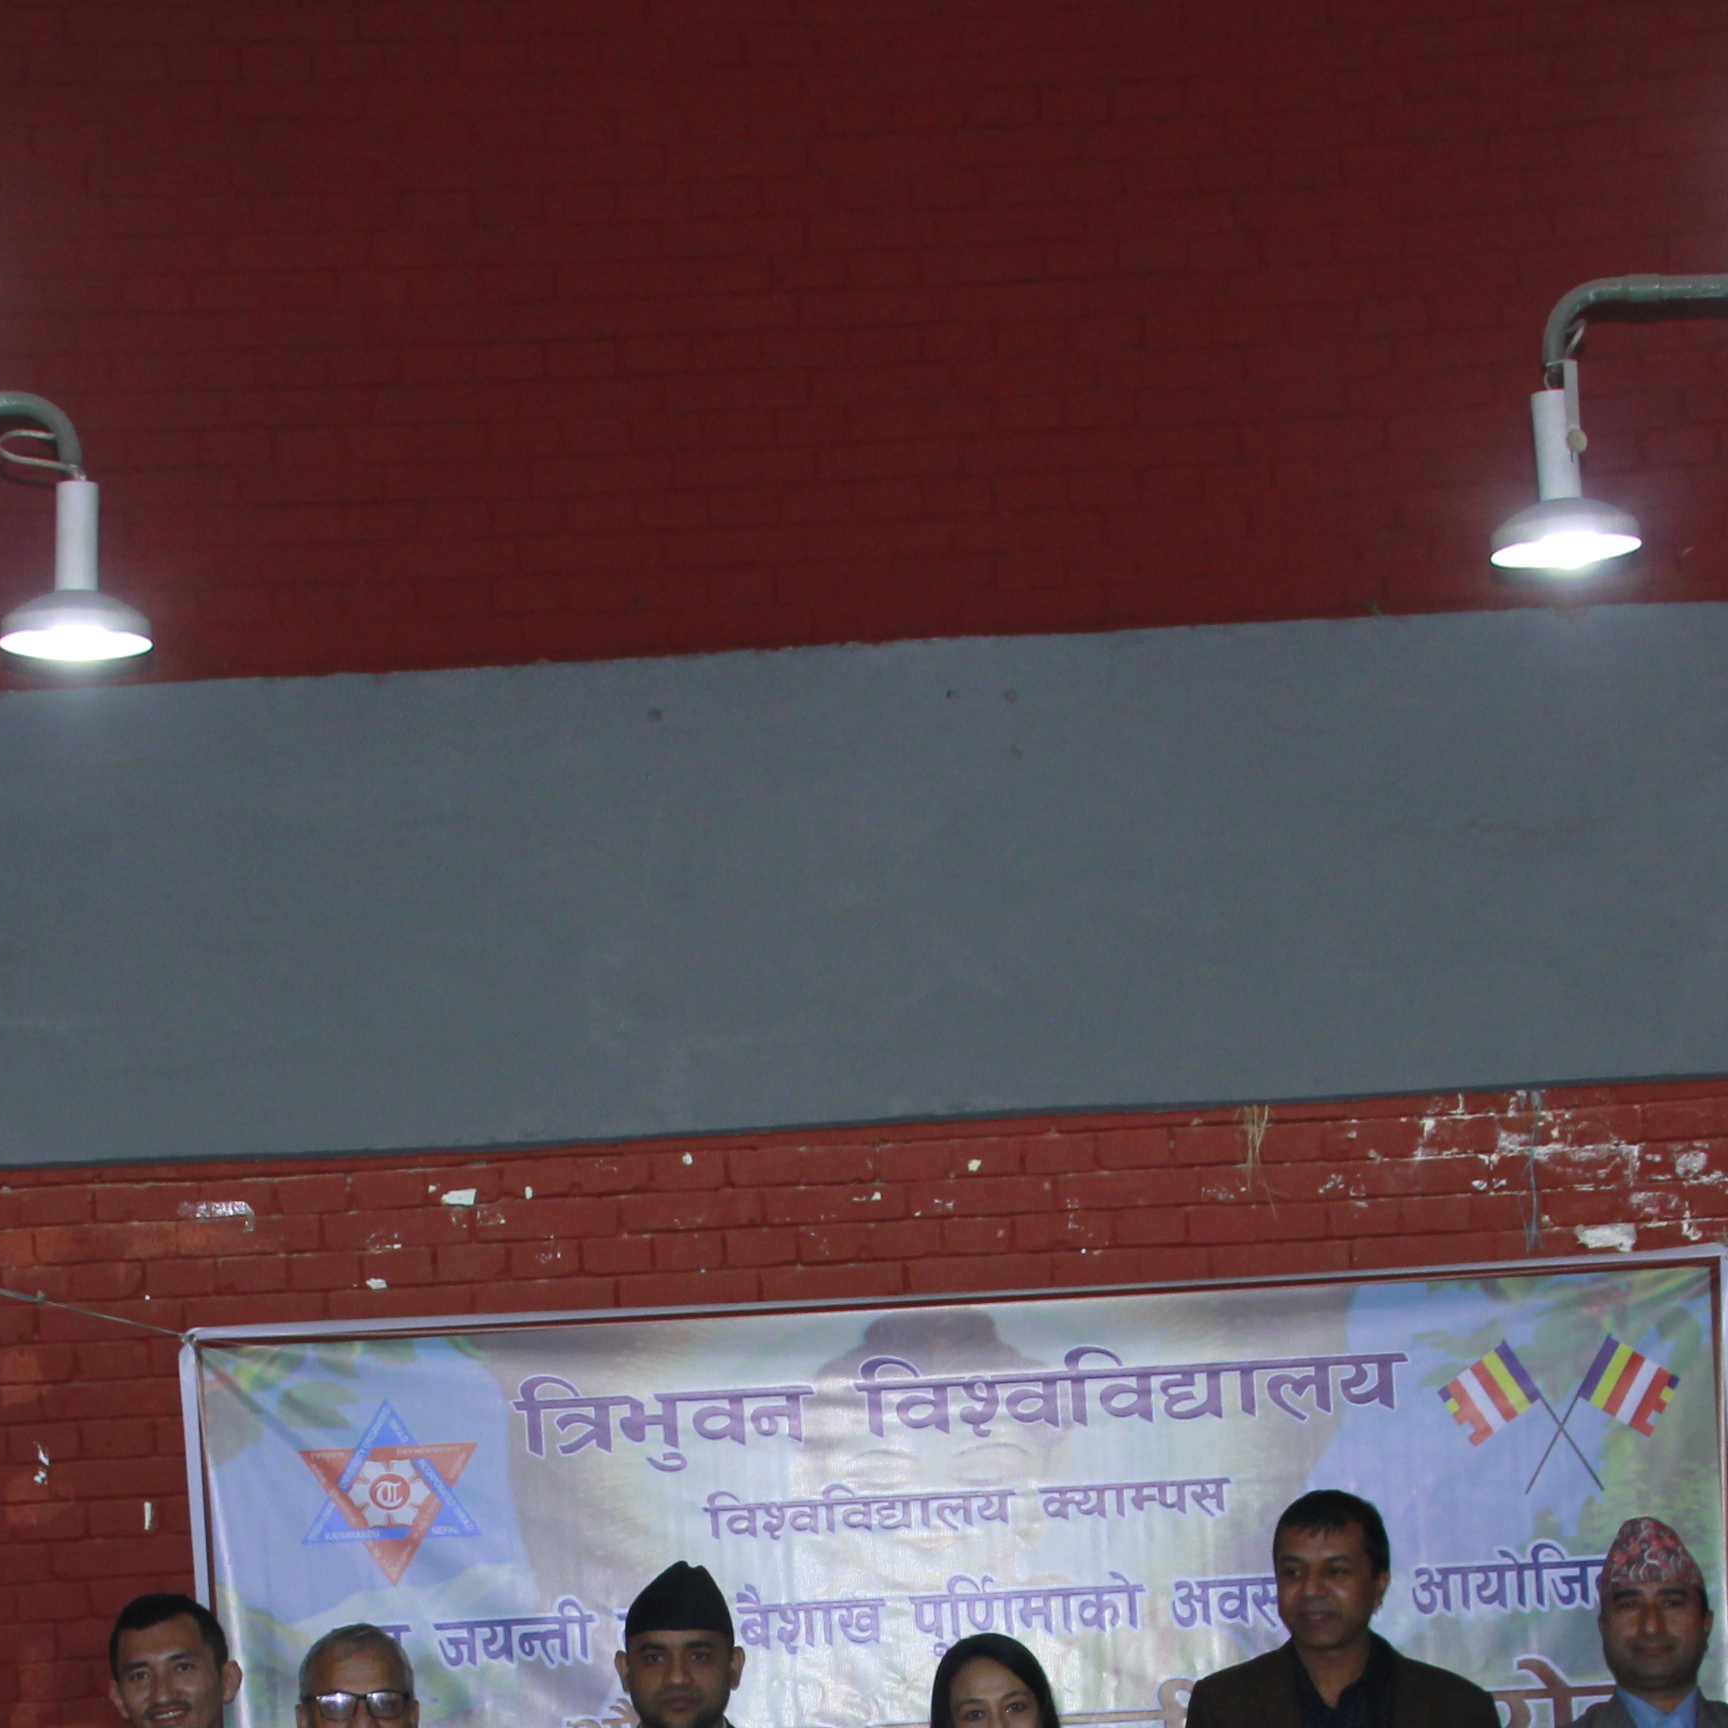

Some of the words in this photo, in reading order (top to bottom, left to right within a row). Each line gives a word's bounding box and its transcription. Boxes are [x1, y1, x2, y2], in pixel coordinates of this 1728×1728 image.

[512, 1376, 815, 1472] त्रिभुवन
[854, 1346, 1409, 1438] विश्वविद्यालय
[703, 1485, 1017, 1540] विश्वविद्यालय
[1039, 1477, 1231, 1516] क्याम्पस
[433, 1597, 595, 1667] जयन्ती
[735, 1583, 886, 1655] बैशाख
[1412, 1542, 1606, 1614] आयोजि
